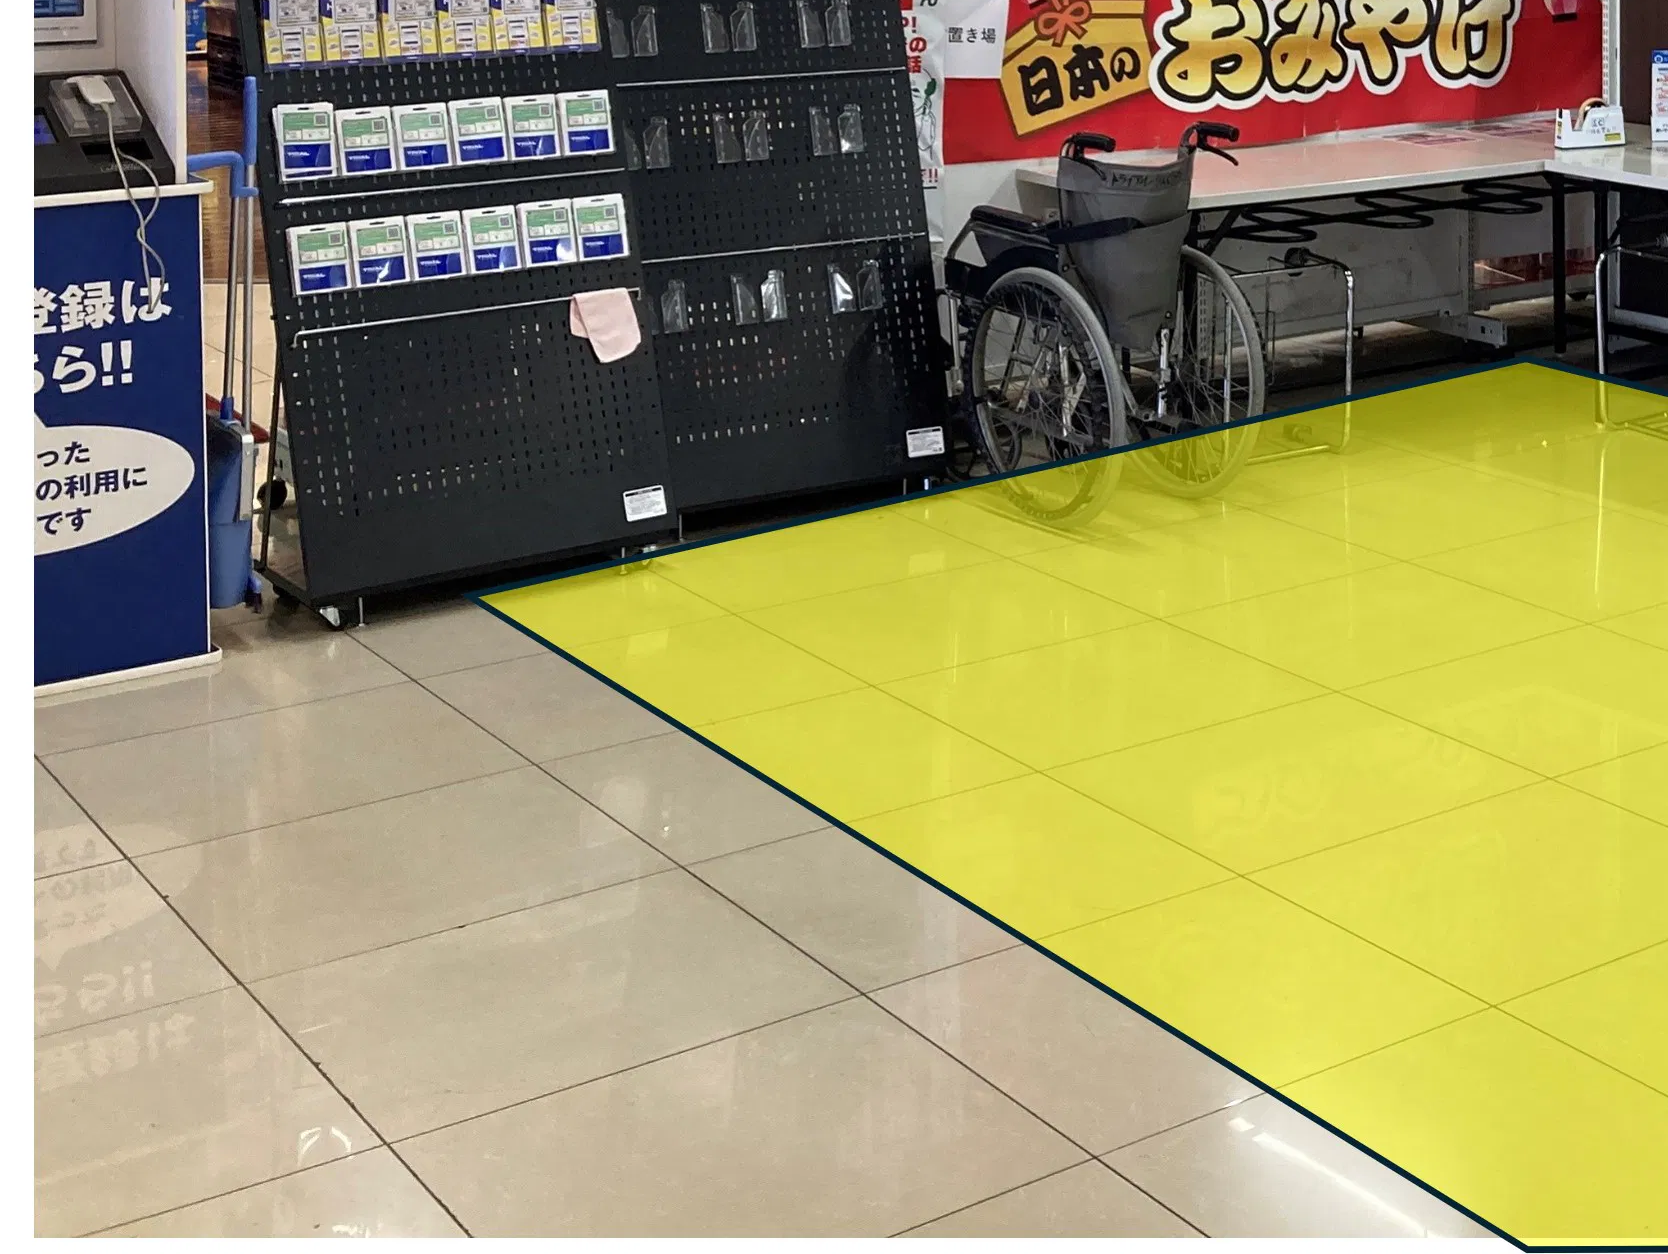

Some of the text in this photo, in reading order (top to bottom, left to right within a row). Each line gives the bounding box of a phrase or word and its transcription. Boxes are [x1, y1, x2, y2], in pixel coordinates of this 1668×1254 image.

[948, 27, 996, 44] 置き場
[1018, 45, 1143, 117] 日本の
[34, 340, 133, 394] ら!!
[37, 441, 90, 467] った
[36, 466, 148, 501] の利用に
[36, 507, 92, 536] です
